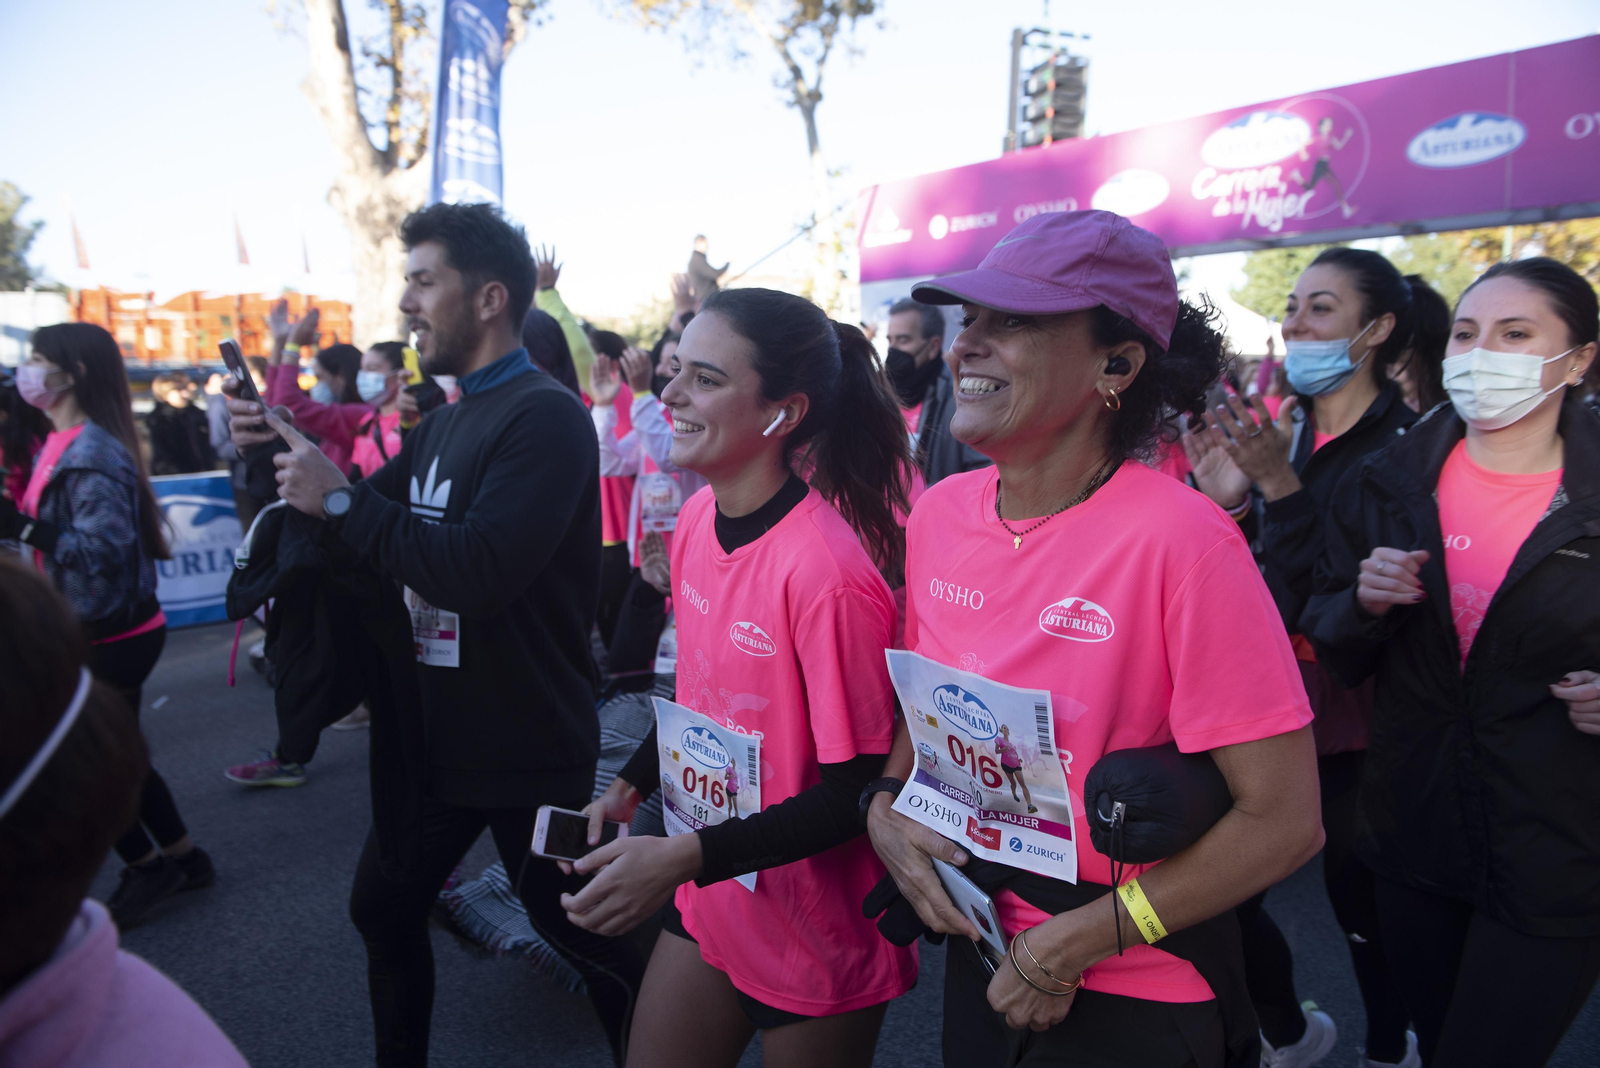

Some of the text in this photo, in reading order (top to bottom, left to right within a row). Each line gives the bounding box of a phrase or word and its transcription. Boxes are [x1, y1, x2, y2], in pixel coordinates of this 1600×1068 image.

[680, 579, 709, 615] OYSHO
[930, 577, 984, 610] OYSHO
[732, 626, 773, 653] ASTURIANA
[1041, 609, 1108, 637] ASTURIANA
[938, 693, 994, 735] ASTURIANA
[684, 733, 727, 765] ASTURIANA
[947, 734, 1003, 789] 016
[683, 766, 725, 808] 016
[692, 804, 709, 822] 181
[908, 794, 962, 828] OYSHO
[939, 782, 976, 808] CARRERA
[998, 812, 1040, 830] MUJER
[1026, 844, 1064, 863] ZURICH
[1145, 920, 1161, 941] URNO
